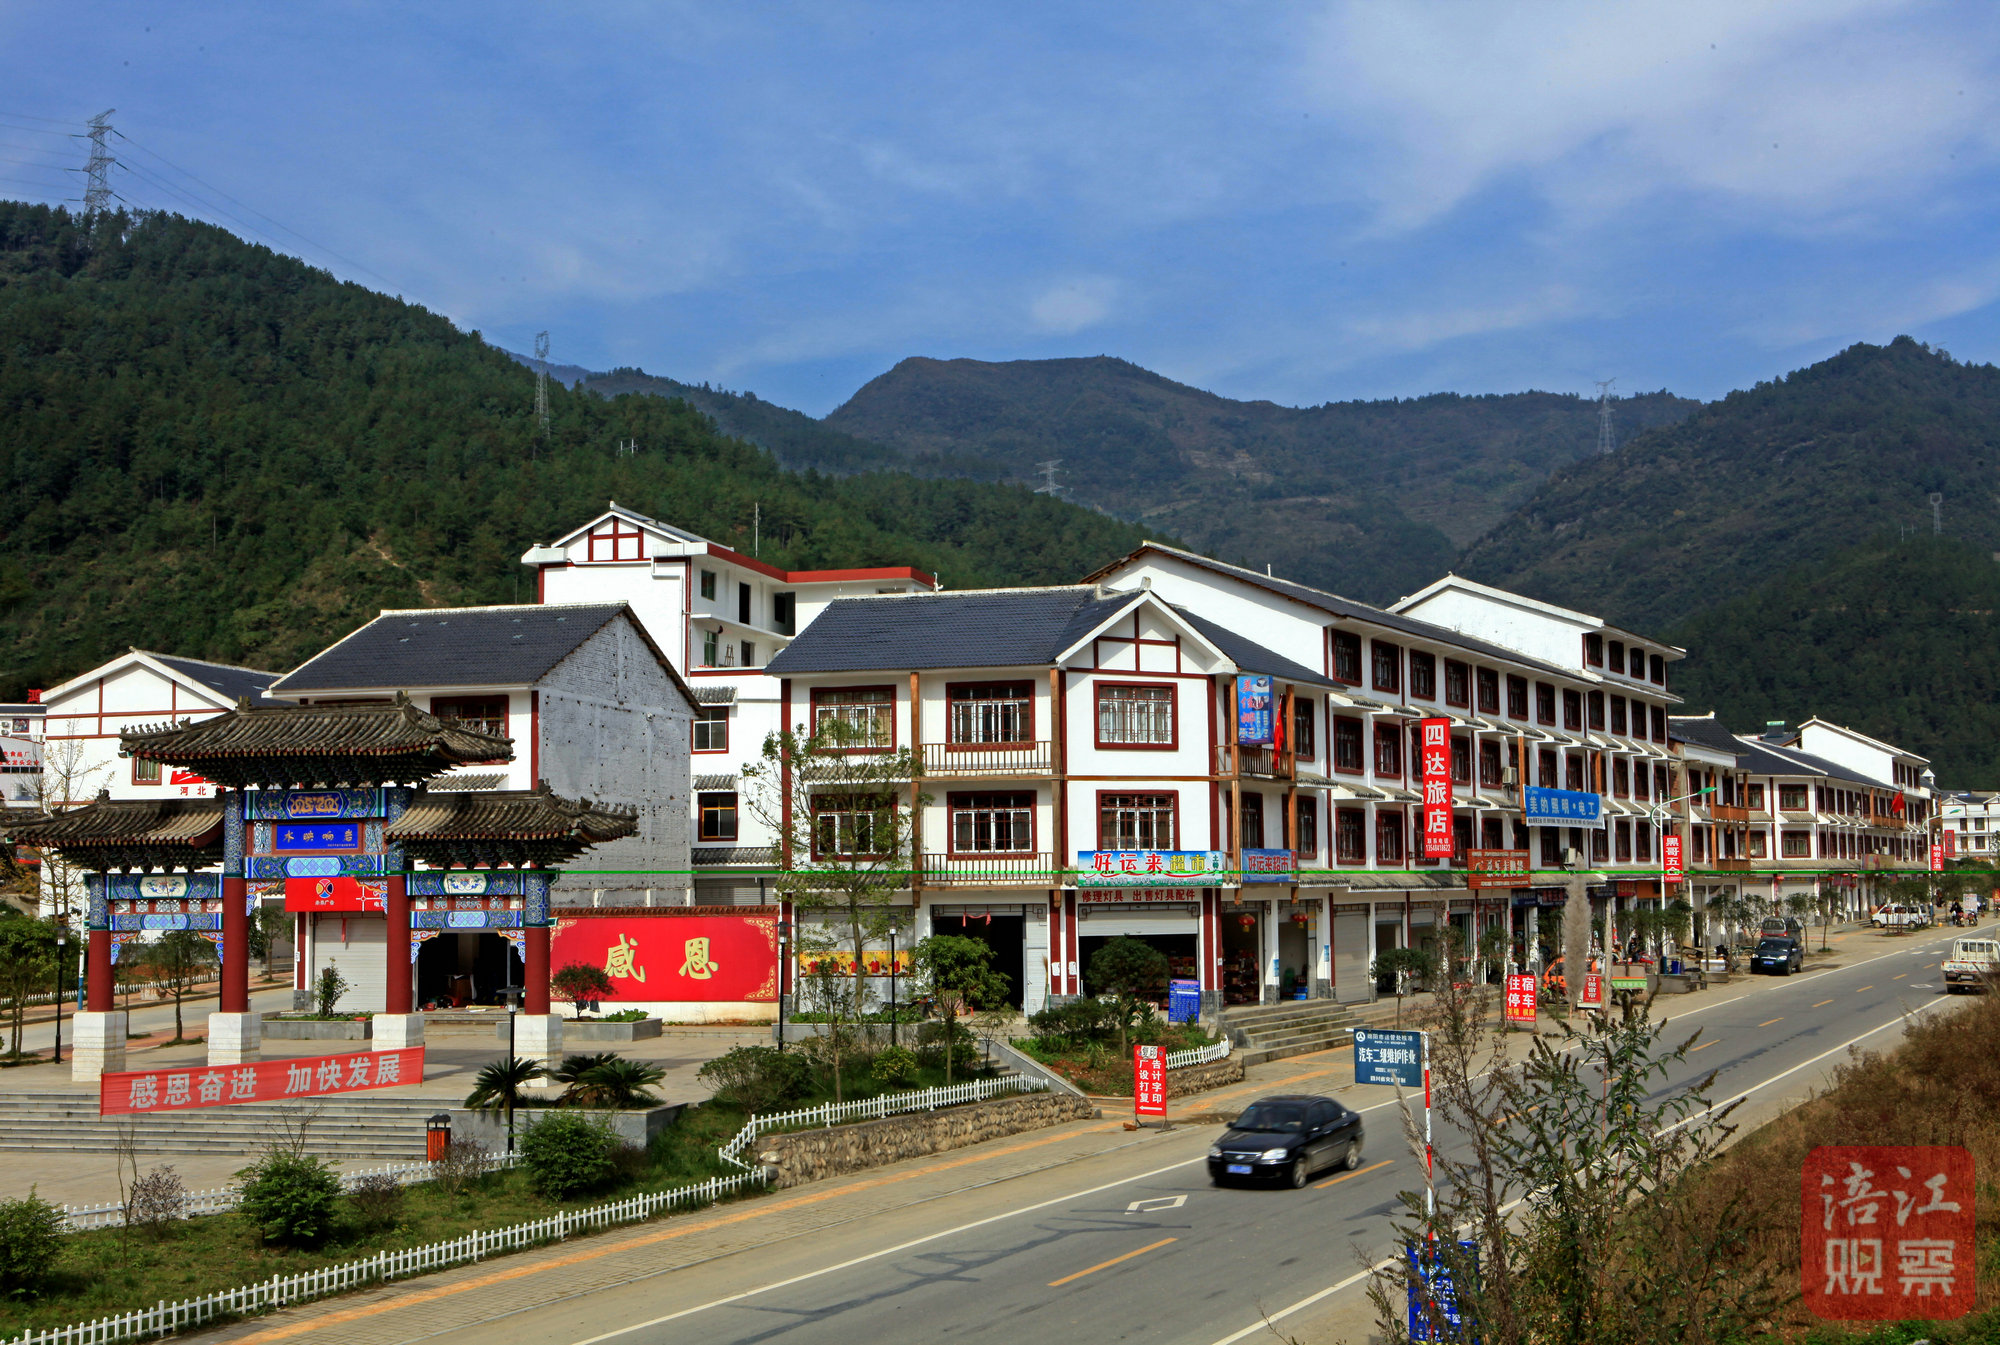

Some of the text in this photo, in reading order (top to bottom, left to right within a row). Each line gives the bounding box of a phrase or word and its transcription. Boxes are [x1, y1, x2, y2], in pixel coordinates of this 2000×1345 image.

[1425, 724, 1447, 834] 四达旅店
[1093, 853, 1206, 872] 好运来超市
[1082, 888, 1195, 902] 修理灯具 出售灯具配件
[604, 933, 719, 983] 感恩
[1508, 976, 1535, 991] 住宿
[1507, 993, 1535, 1008] 停车
[1358, 1047, 1416, 1065] 汽车二级维护作业
[1139, 1059, 1162, 1070] 广告
[129, 1053, 400, 1108] 感恩奋进 加快发展
[1139, 1070, 1162, 1081] 设计
[1139, 1081, 1162, 1092] 打字
[1139, 1092, 1162, 1104] 复印
